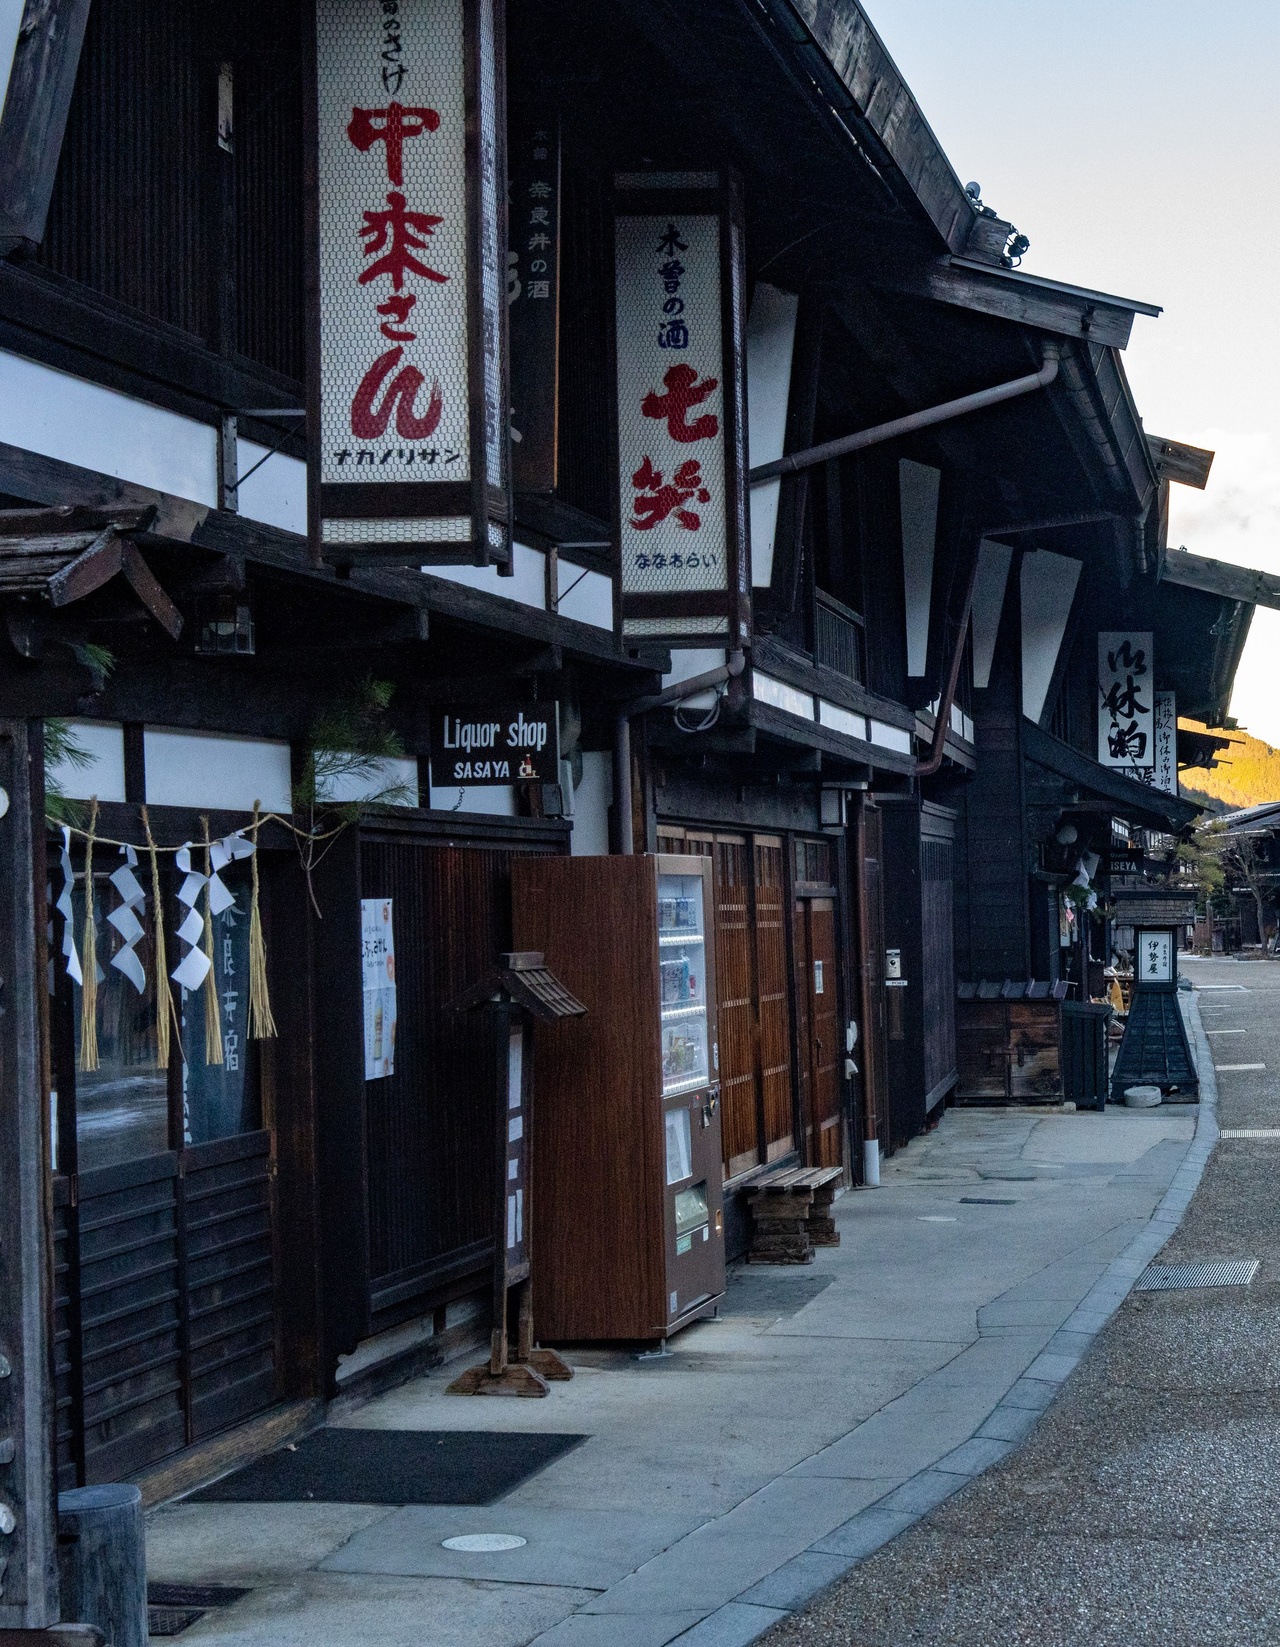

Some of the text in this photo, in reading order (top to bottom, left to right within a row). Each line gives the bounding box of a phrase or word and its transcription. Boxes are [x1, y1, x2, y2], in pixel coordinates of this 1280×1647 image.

[528, 181, 551, 298] 奈良井の酒
[655, 224, 689, 350] 木曽の酒
[333, 449, 459, 466] ナカノリサン
[628, 363, 719, 531] 七笑
[635, 553, 718, 570] ななわらい
[443, 712, 547, 753] Liquor shop
[453, 760, 510, 779] SASAYA
[1110, 861, 1137, 871] ISEYA
[1147, 940, 1159, 974] 伊勢屋
